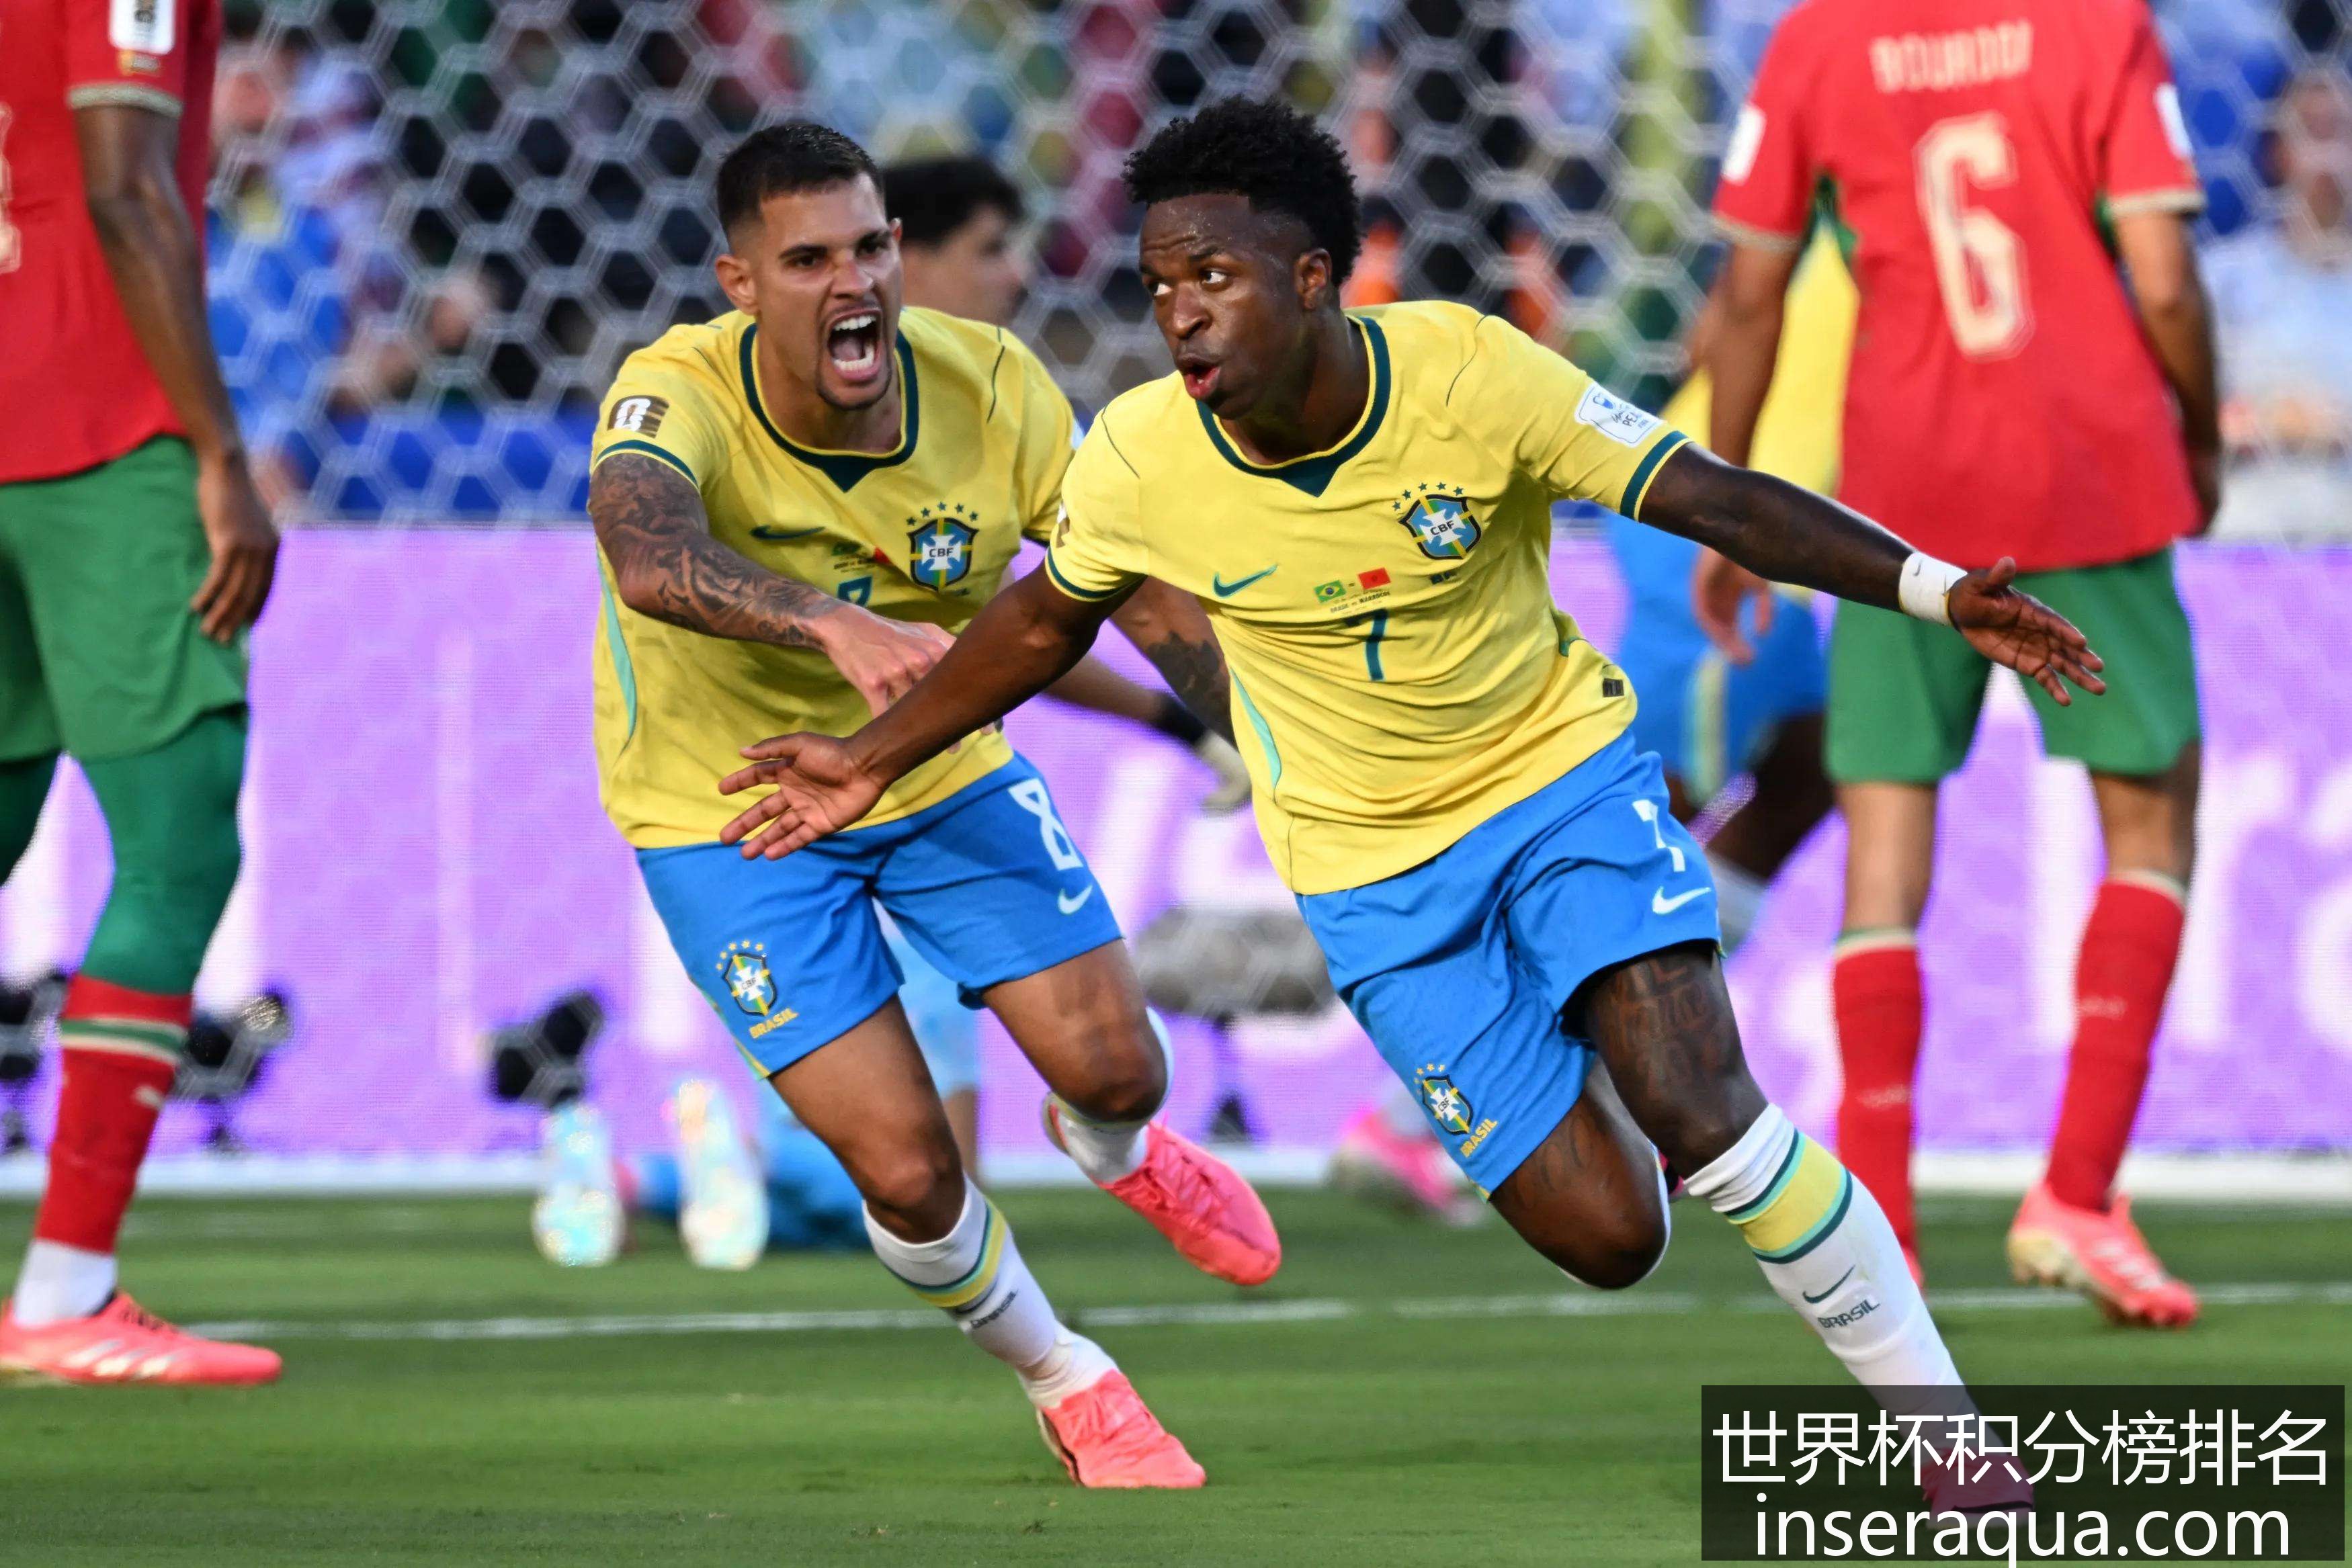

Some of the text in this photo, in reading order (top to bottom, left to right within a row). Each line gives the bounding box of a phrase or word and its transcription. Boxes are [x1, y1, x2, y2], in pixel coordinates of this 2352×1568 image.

[1912, 110, 2035, 362] 6
[1430, 520, 1455, 535] CBF
[929, 547, 954, 558] CBF
[1344, 607, 1389, 681] 7
[1009, 778, 1084, 871] 8
[1632, 799, 1686, 872] 7
[749, 1008, 799, 1039] BRASIL
[1438, 1097, 1450, 1112] CBF
[1460, 1118, 1498, 1158] BRASIL
[1817, 1299, 1881, 1329] BRASIL
